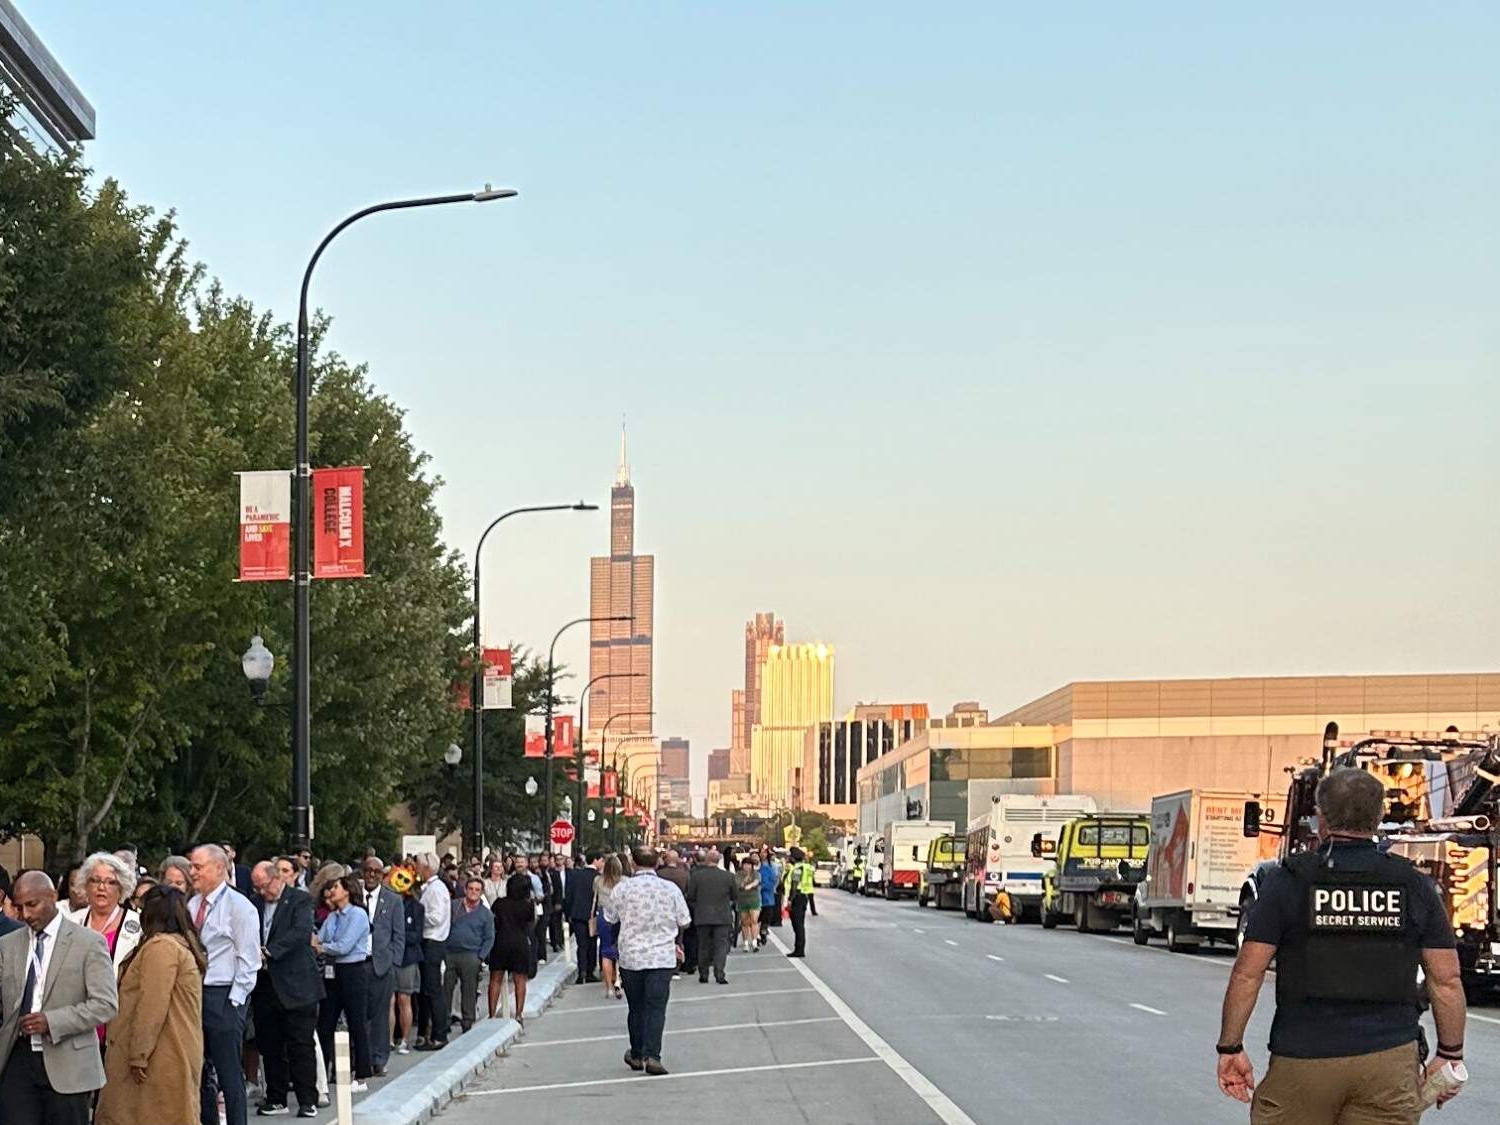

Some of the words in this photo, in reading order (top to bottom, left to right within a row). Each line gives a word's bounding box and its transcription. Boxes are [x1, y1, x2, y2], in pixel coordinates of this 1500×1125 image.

[245, 513, 280, 521] PARAMEDIC
[324, 488, 337, 535] COLLEGE
[339, 486, 352, 539] MALCOLM
[550, 827, 573, 838] STOP
[1315, 889, 1401, 912] POLICE
[1315, 915, 1355, 926] SECRET
[1357, 916, 1401, 927] SERVICE
